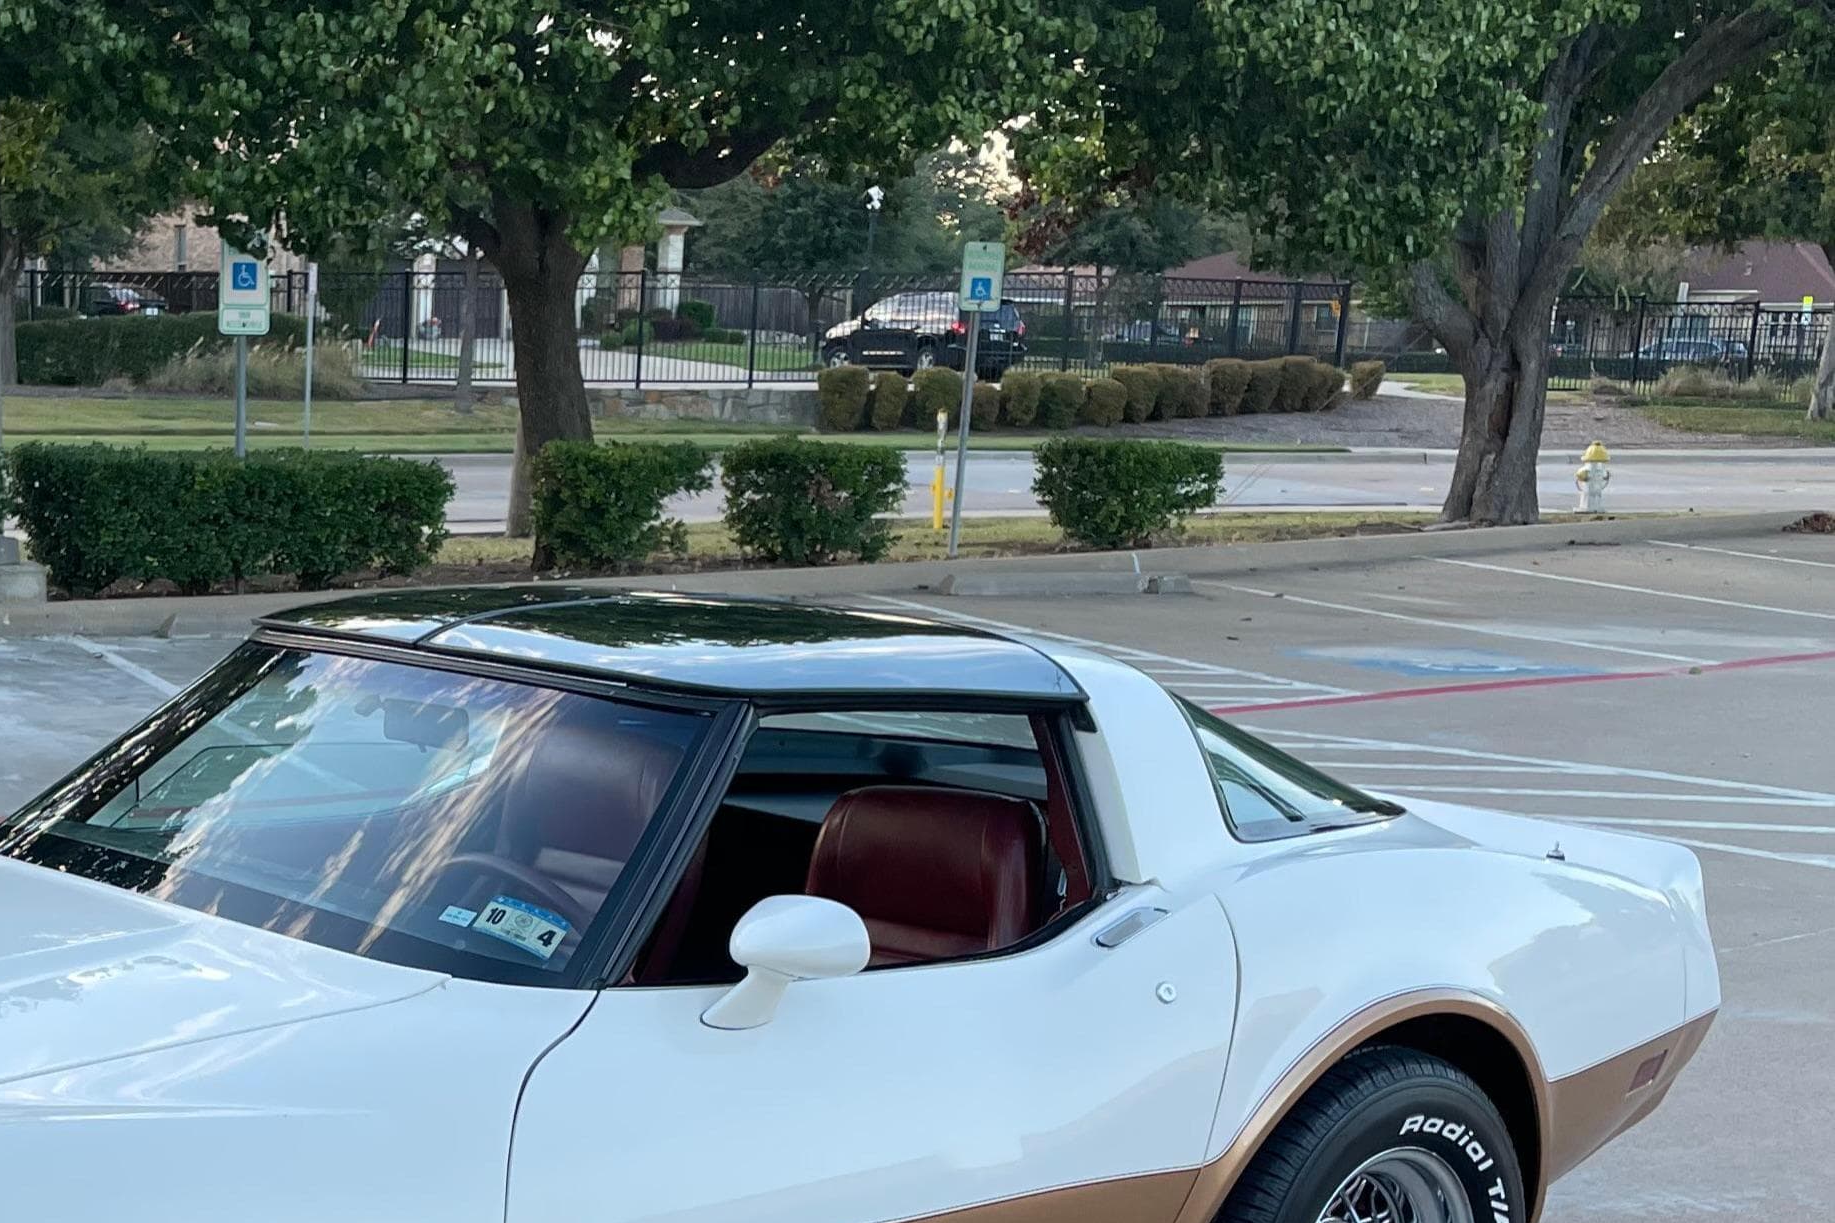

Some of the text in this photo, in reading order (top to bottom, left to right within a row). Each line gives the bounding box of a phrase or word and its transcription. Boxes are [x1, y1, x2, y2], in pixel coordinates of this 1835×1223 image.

[485, 907, 507, 925] 10
[537, 929, 557, 947] 4
[1399, 1114, 1494, 1172] Radial
